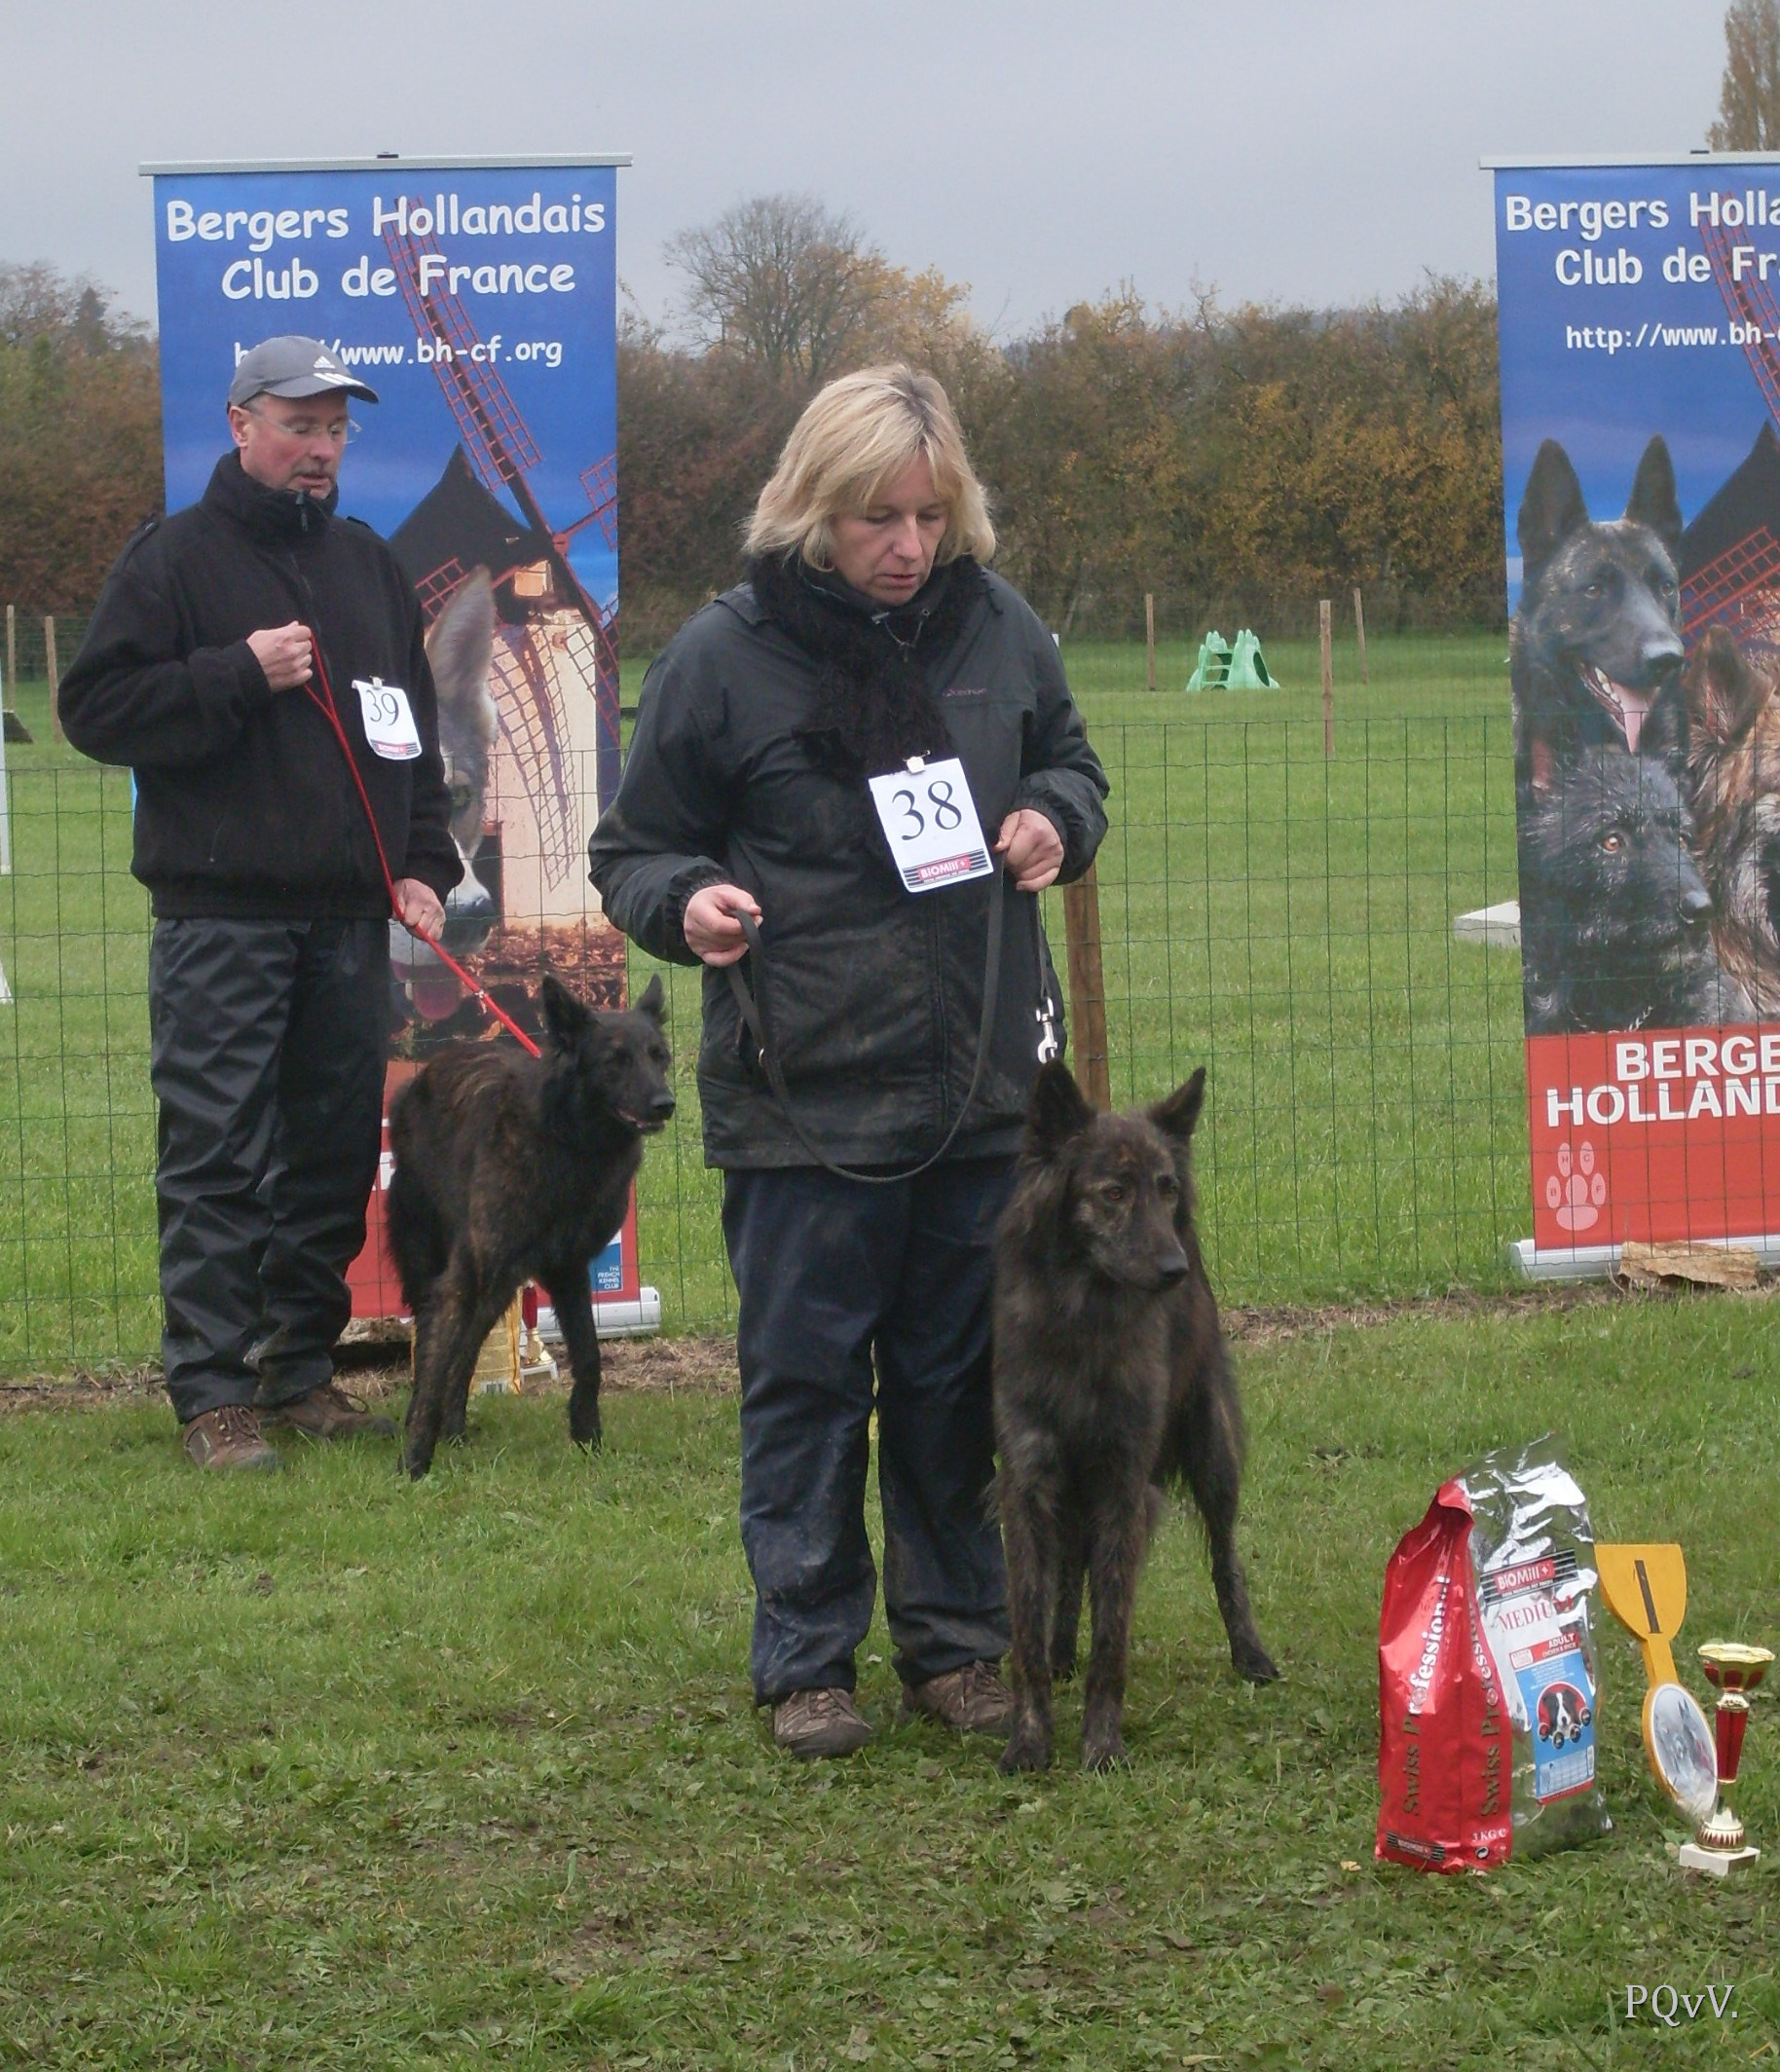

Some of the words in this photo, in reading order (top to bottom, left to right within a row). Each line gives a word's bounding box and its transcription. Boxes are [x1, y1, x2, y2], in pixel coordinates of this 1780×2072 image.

[167, 200, 350, 252] Bergers
[373, 192, 606, 237] Hollandais
[1505, 196, 1670, 241] Bergers
[222, 257, 319, 300] Club
[341, 255, 397, 297] de
[419, 254, 576, 297] France
[1555, 248, 1644, 286] Club
[1662, 246, 1711, 283] de
[1731, 246, 1780, 282] Fr
[1566, 321, 1780, 355] http://www.bh-
[365, 689, 399, 726] 39
[891, 780, 962, 841] 38
[1615, 1035, 1780, 1082] BERGE
[1548, 1633, 1575, 1649] ADULT
[1402, 1745, 1421, 1816] Swiss
[1481, 1744, 1501, 1816] Swiss
